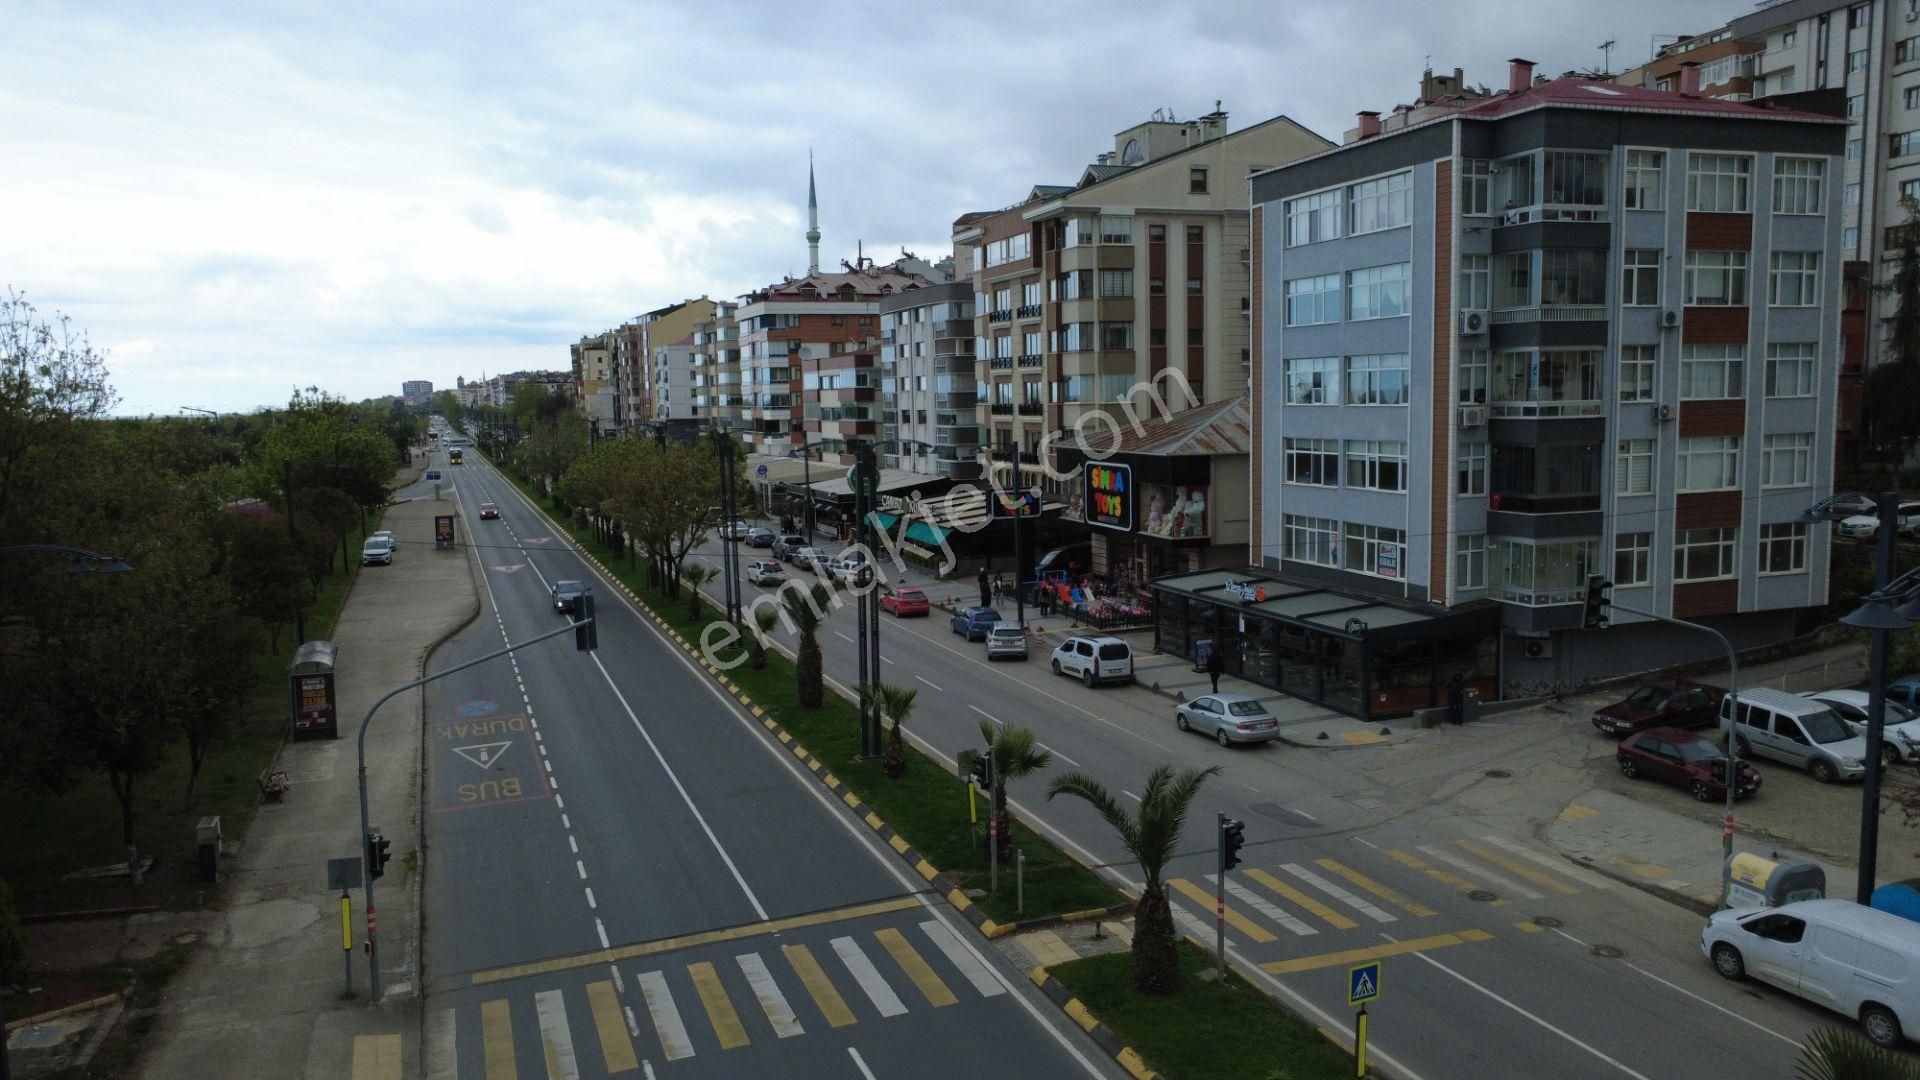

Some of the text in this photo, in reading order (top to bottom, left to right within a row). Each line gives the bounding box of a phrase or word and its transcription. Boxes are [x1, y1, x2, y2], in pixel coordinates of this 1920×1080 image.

[1093, 491, 1122, 518] TOYS
[437, 717, 525, 740] DURAK
[459, 778, 522, 802] BUS
